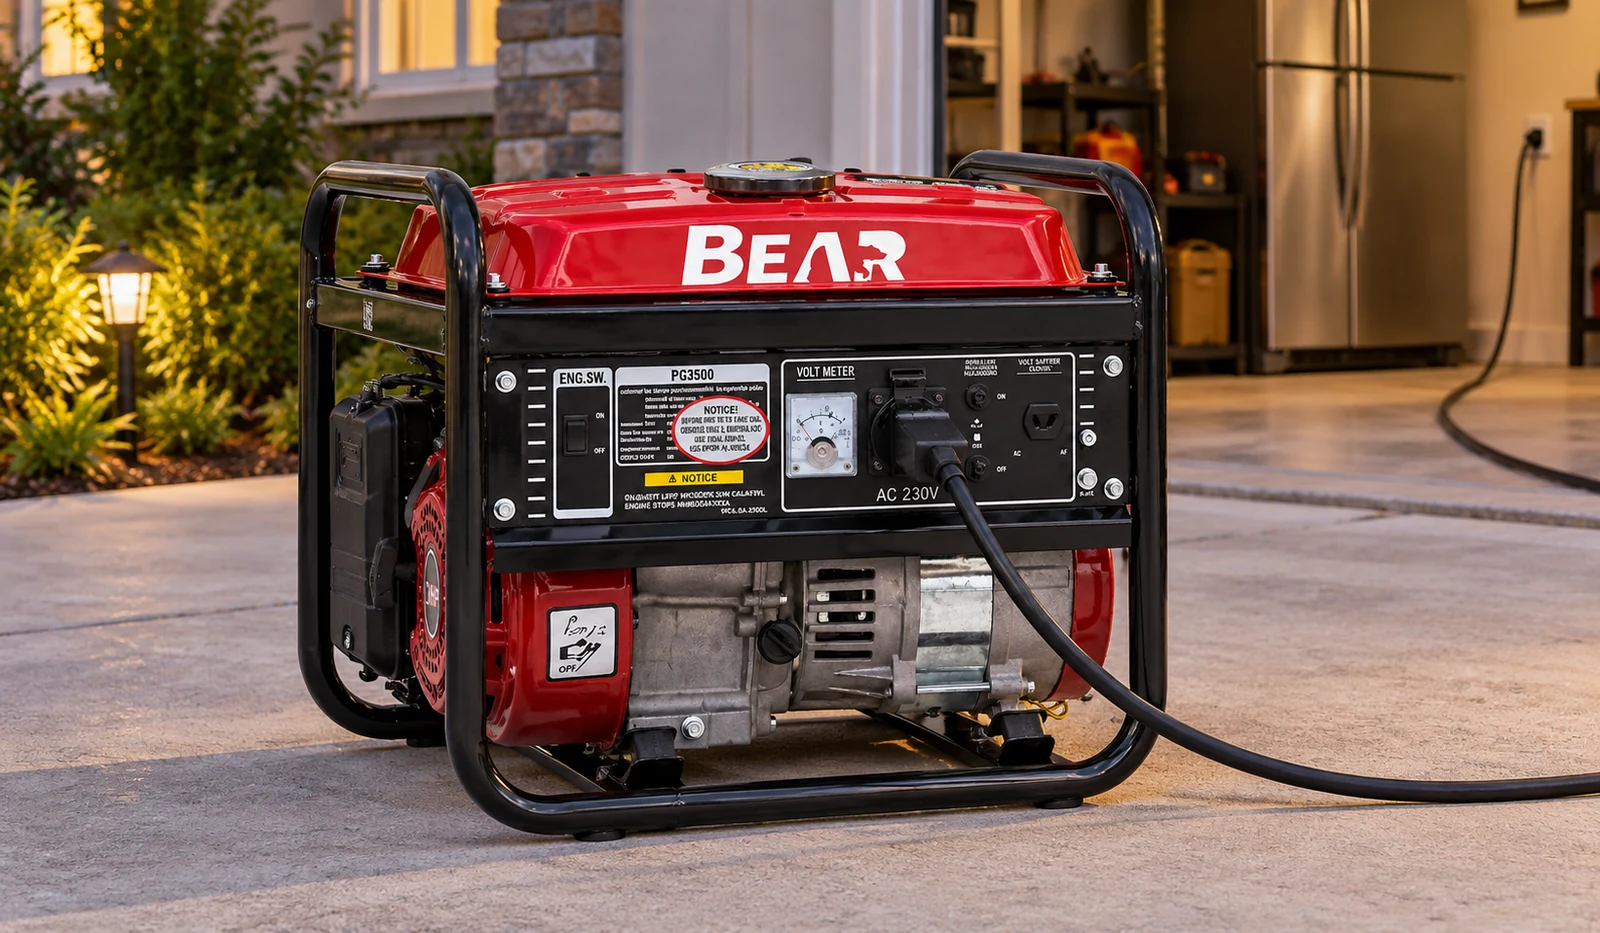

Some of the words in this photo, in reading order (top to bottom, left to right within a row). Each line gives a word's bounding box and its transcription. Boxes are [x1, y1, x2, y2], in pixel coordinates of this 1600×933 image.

[682, 224, 906, 286] BEAR
[559, 371, 607, 385] ENG.SW.
[671, 368, 714, 382] PG3500
[797, 366, 820, 378] VOLT
[822, 365, 855, 377] METER
[703, 405, 739, 415] NOTICE!
[593, 447, 606, 455] OFF
[996, 465, 1007, 473] OFF
[682, 473, 718, 483] NOTICE
[876, 487, 897, 502] AC
[902, 486, 939, 501] 230V
